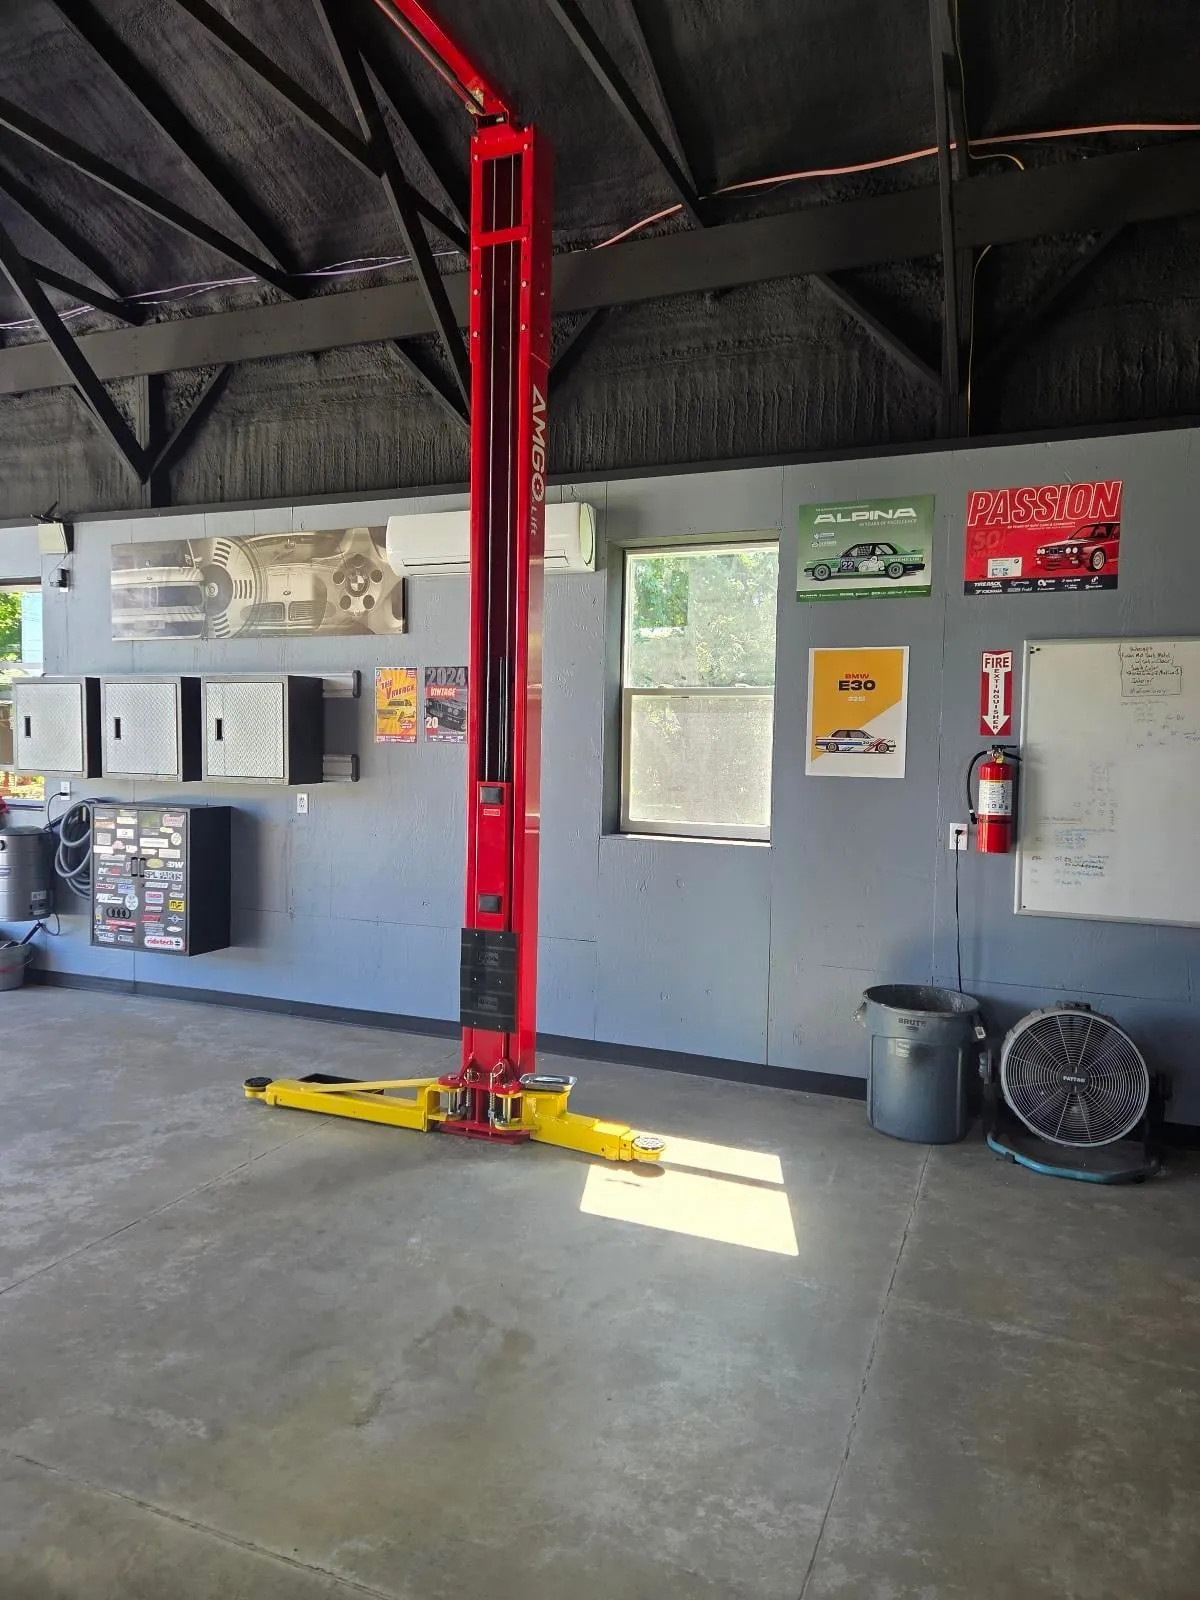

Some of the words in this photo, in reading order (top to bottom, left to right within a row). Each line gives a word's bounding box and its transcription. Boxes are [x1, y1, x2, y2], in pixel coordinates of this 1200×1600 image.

[532, 384, 546, 502] AMGO
[967, 481, 1122, 527] PASSION
[813, 507, 917, 525] ALPINA
[842, 561, 853, 570] 22
[984, 657, 1010, 668] FIRE
[427, 667, 466, 686] 2024
[381, 679, 393, 689] THE
[838, 680, 876, 691] E30
[386, 684, 415, 700] VINTAGE
[430, 687, 457, 697] VINTAGE
[992, 669, 1000, 730] EXTINGUISHER
[426, 716, 439, 729] 20
[147, 938, 173, 946] ridetech
